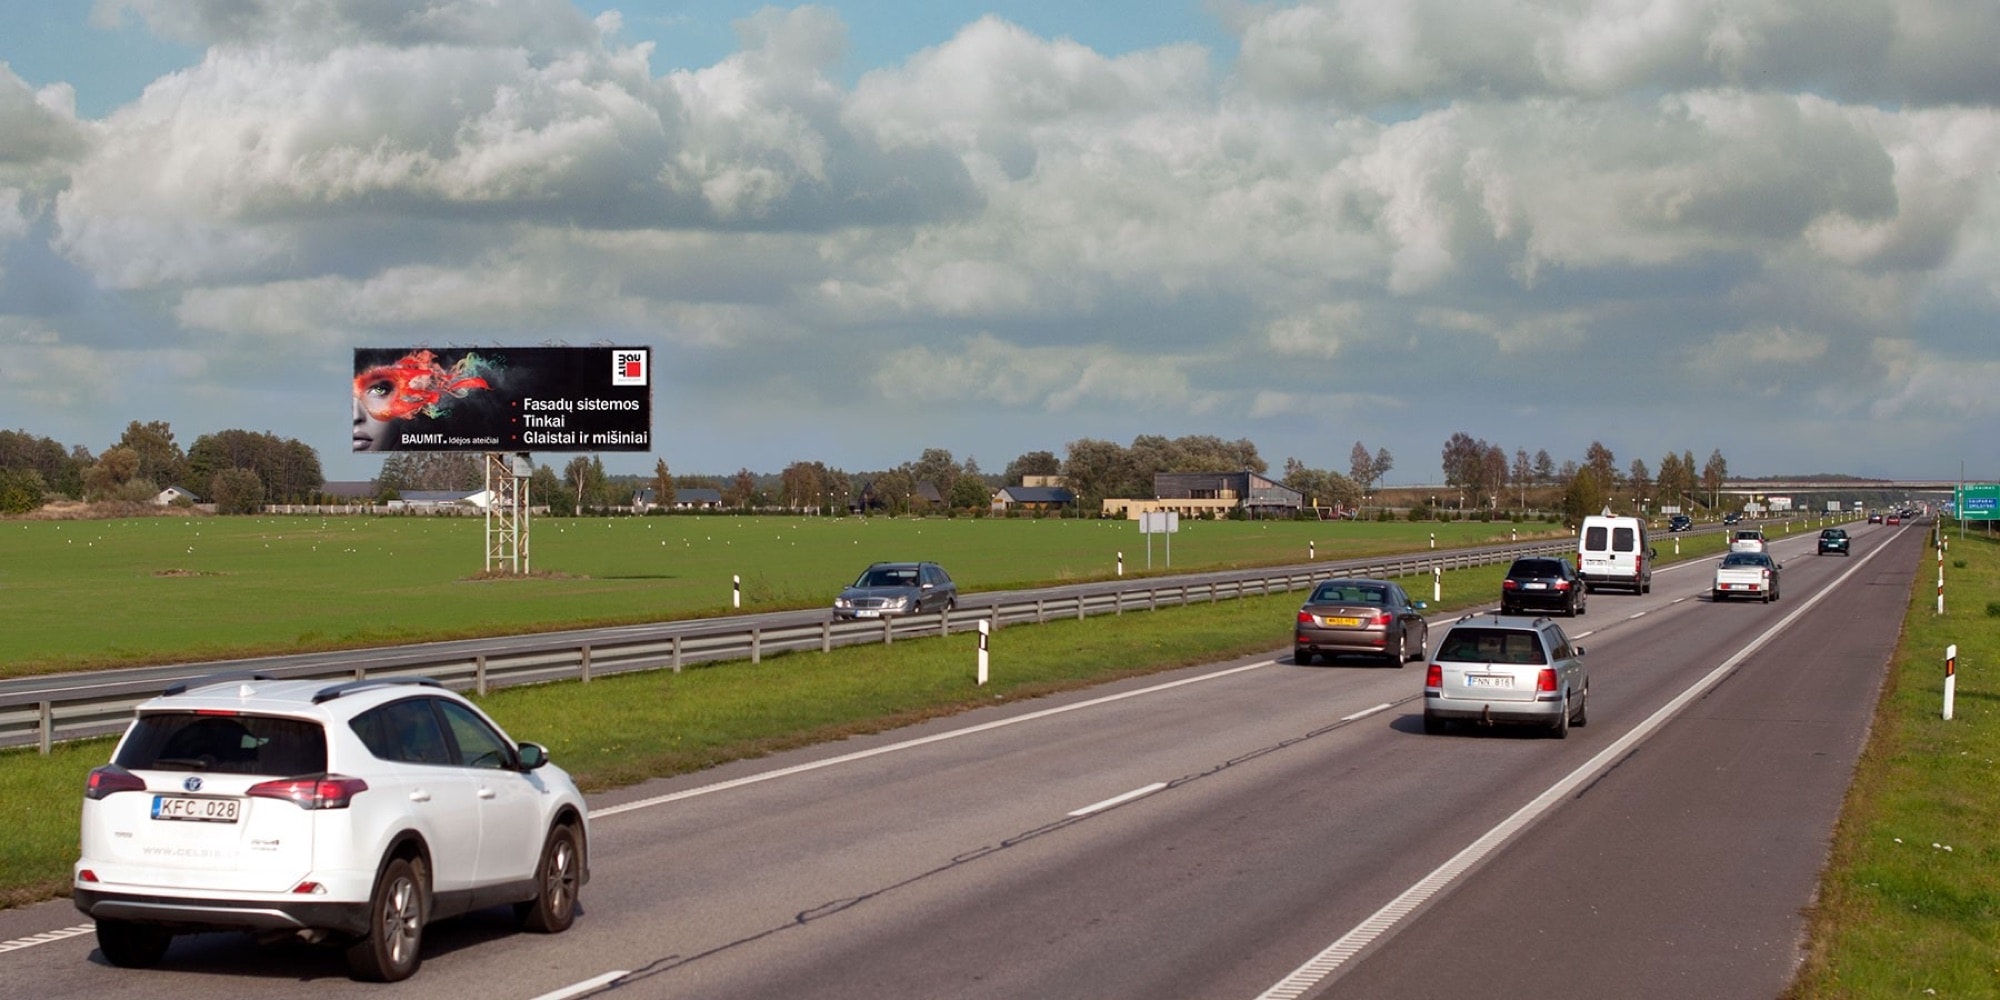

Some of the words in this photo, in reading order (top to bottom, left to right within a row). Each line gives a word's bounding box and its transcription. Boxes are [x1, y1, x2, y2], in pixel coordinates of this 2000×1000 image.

[523, 398, 573, 413] Fasadų
[576, 398, 640, 411] sistemos
[523, 414, 565, 427] Tinkai
[523, 431, 576, 444] Glaistai
[579, 431, 590, 444] ir
[592, 430, 648, 444] mišiniai
[162, 799, 196, 815] KFC
[206, 801, 236, 817] 028
